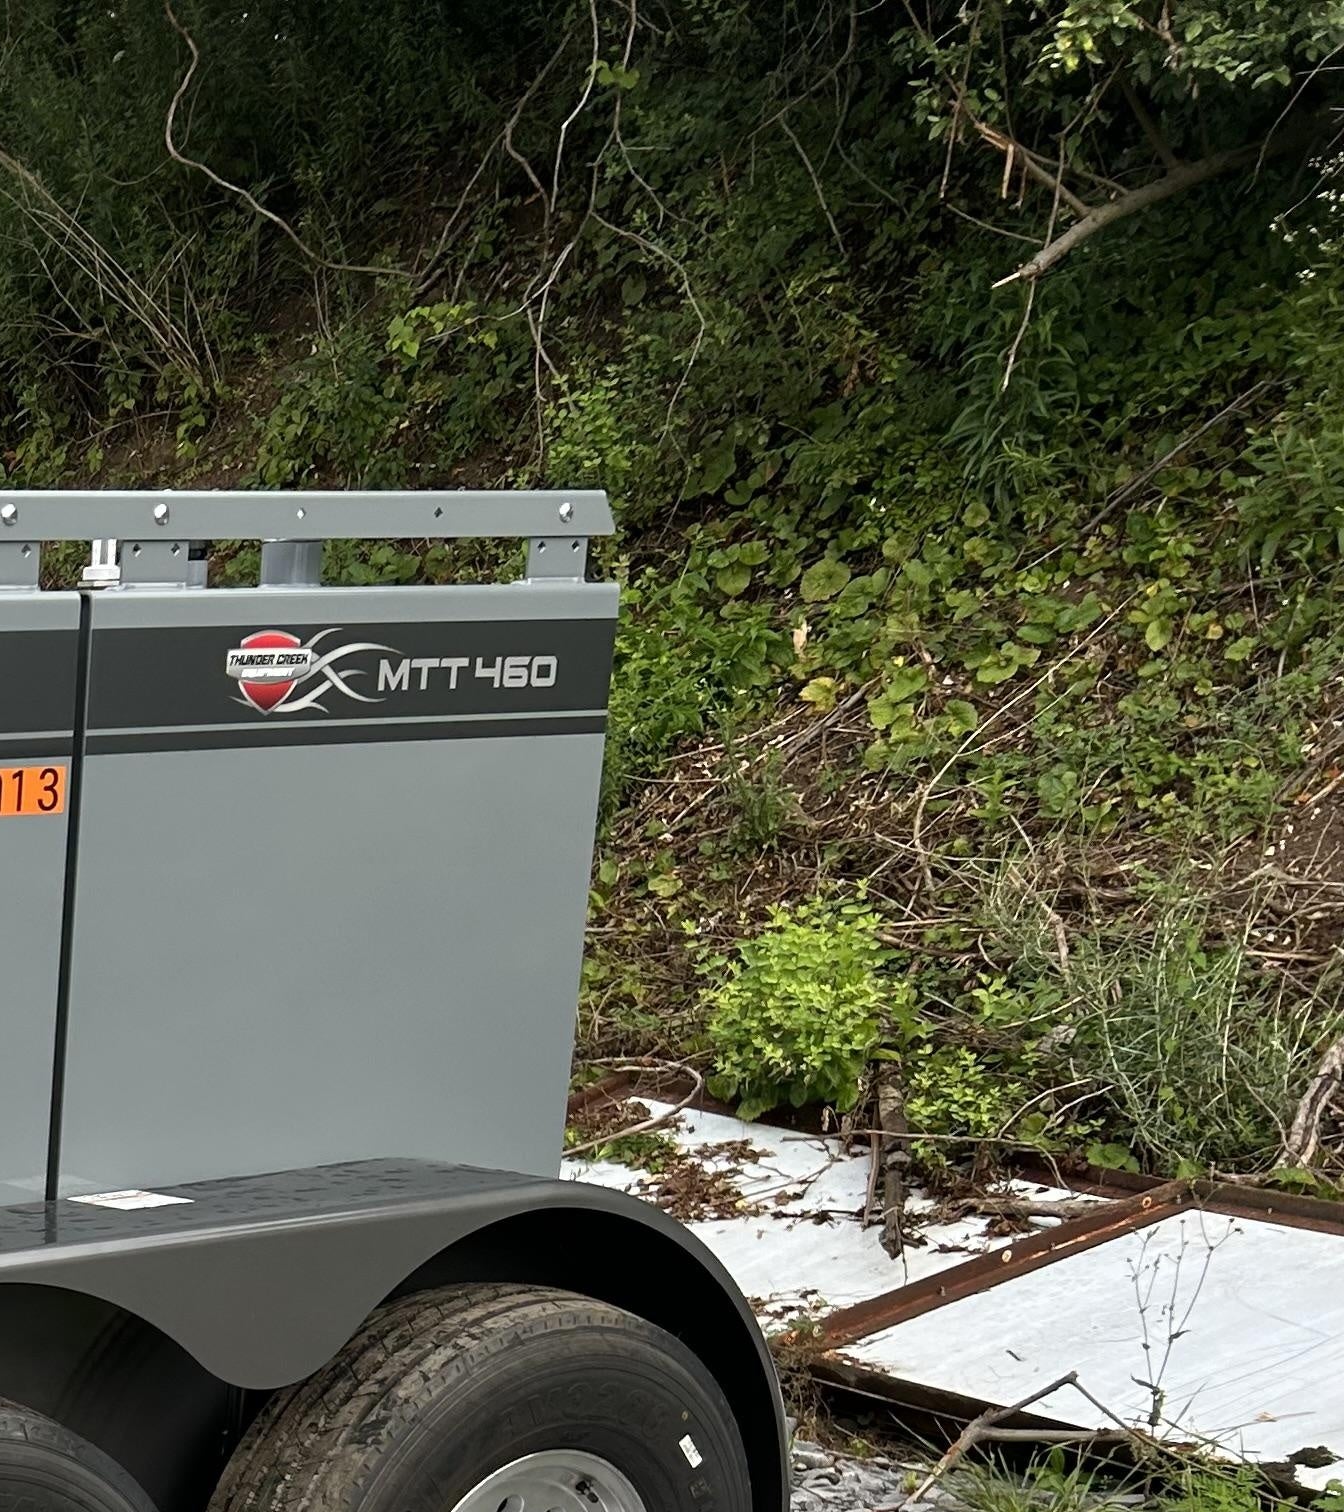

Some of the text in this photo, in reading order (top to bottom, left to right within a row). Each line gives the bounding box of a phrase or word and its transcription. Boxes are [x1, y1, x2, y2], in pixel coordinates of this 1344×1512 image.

[229, 653, 309, 667] THUNDER CREEK
[377, 655, 559, 692] MTT 460
